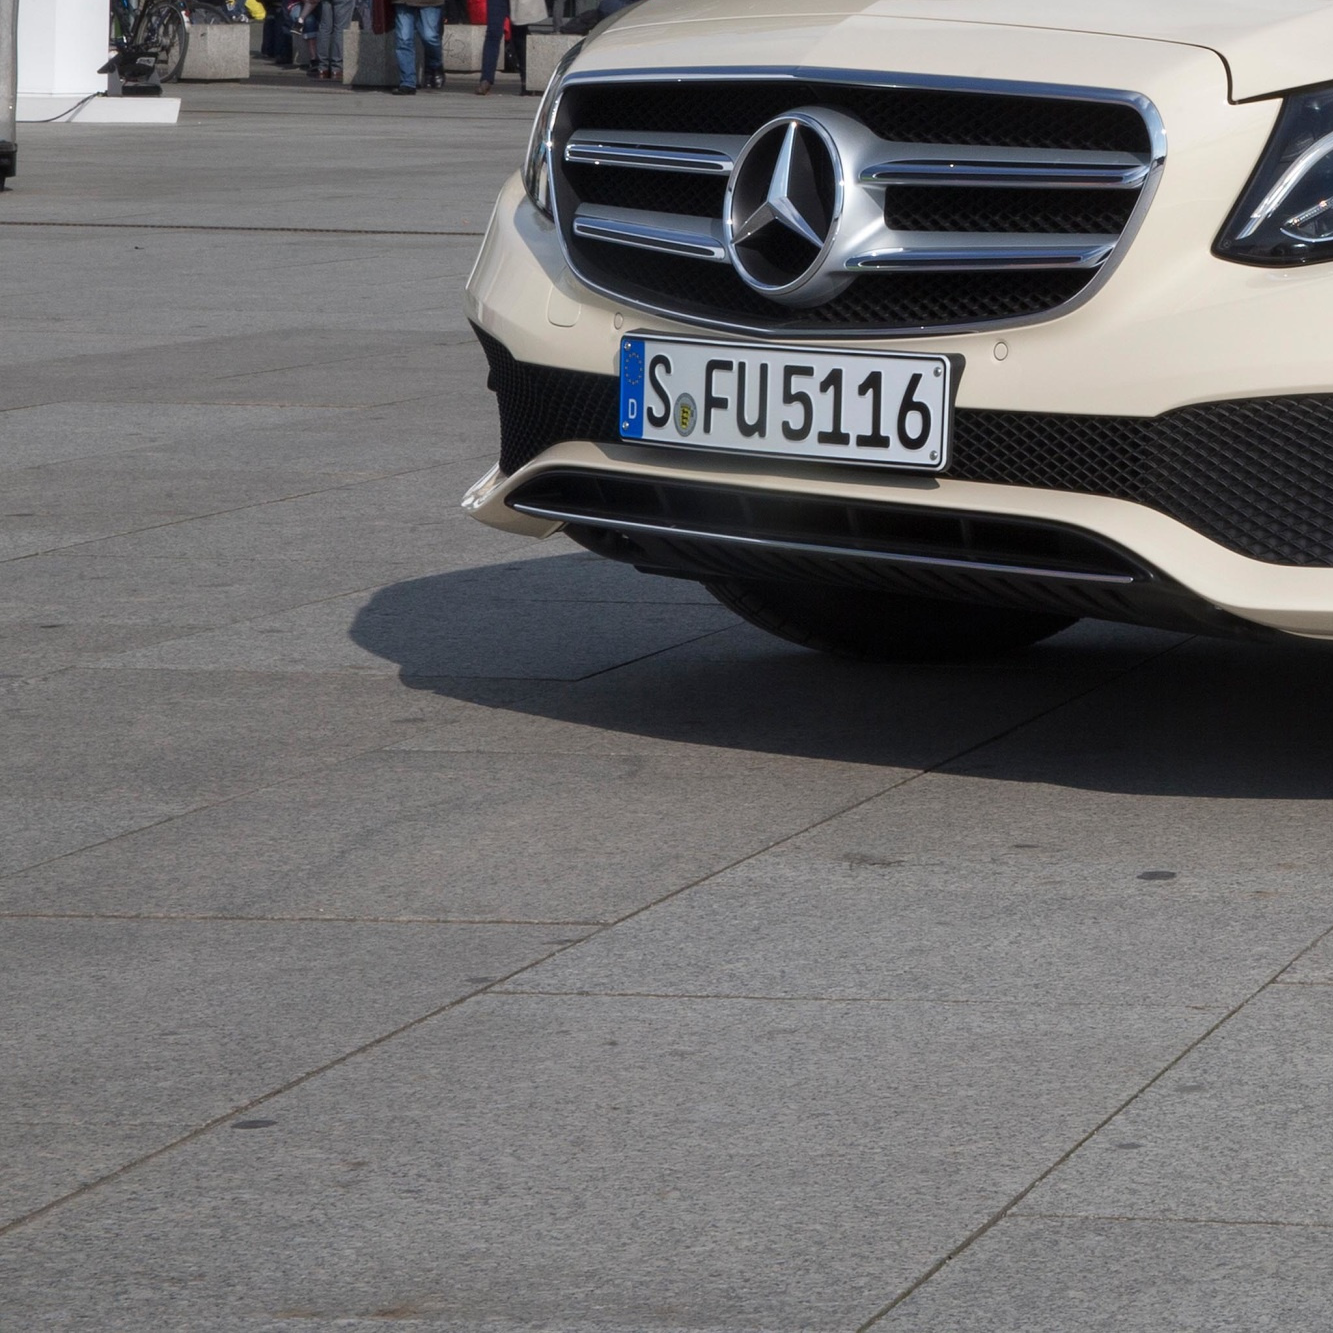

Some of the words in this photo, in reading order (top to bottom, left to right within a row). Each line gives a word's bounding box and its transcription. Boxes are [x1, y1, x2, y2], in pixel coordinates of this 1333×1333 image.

[627, 399, 636, 420] D
[646, 354, 672, 428] S
[702, 359, 769, 437] FU
[781, 365, 933, 451] 5116
